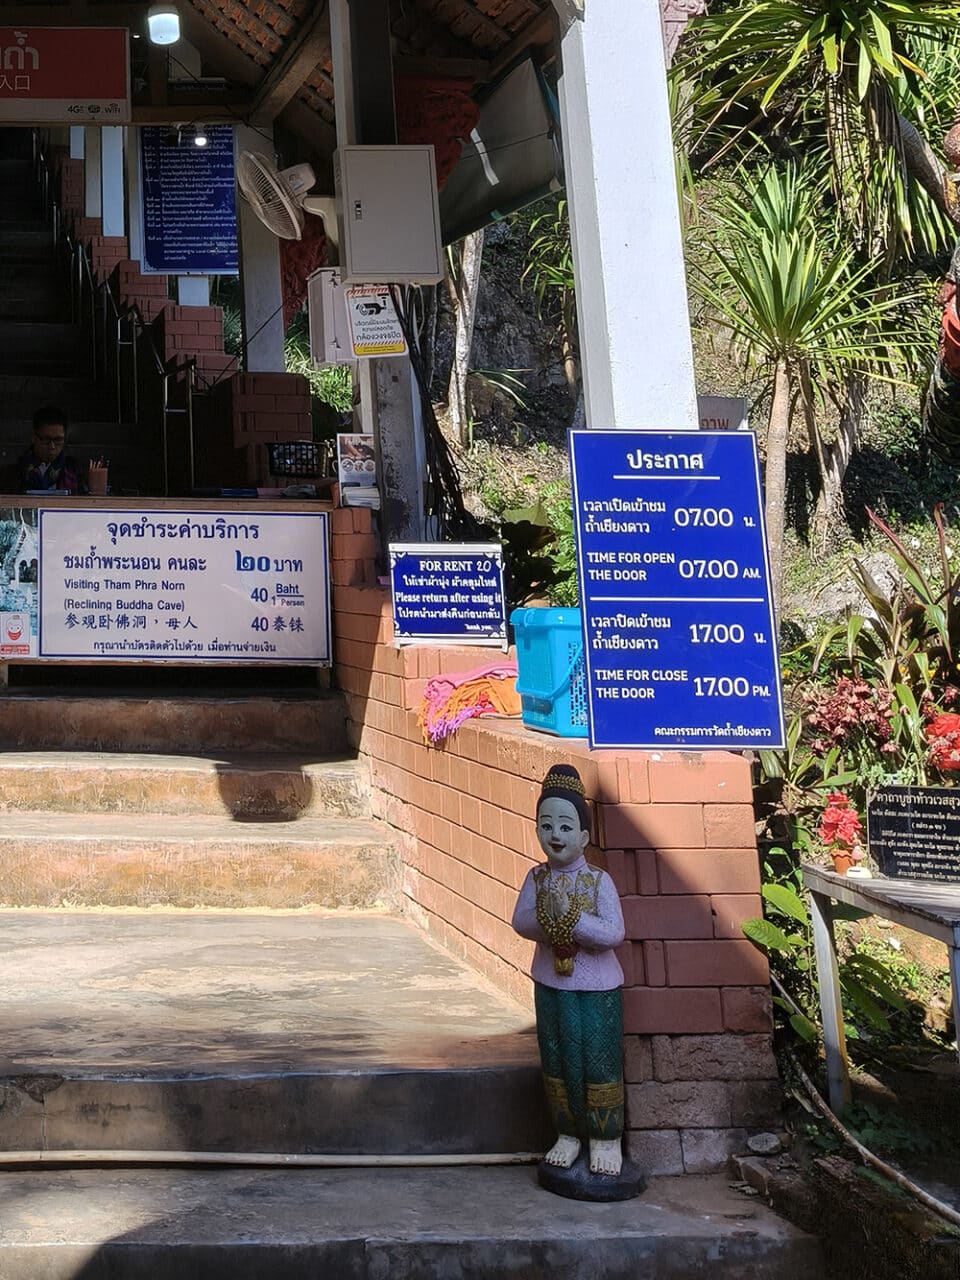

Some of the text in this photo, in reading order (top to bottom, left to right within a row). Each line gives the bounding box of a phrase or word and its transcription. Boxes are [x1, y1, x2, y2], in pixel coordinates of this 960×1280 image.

[626, 449, 704, 470] ประกาศ
[583, 498, 667, 514] เวลาเปิดเข้าชม
[584, 515, 650, 534] ถ้ำเชียงดาว
[673, 507, 756, 528] 07.00 น.
[106, 517, 259, 546] จุดชำระค่าบริการ
[63, 546, 303, 573] ชมถ้ำพระนอน คนละ ๒๐ บาท
[587, 552, 676, 564] TIME FOR OPEN
[419, 561, 492, 573] FOR RENT 20
[588, 569, 648, 581] THE DOOR
[678, 559, 761, 580] 07.00 AM.
[64, 579, 185, 592] Visiting Tham Phra Norn
[250, 583, 300, 603] 40 Baht
[63, 598, 185, 611] (Reclining Buddha Cave)
[271, 596, 276, 606] 1
[395, 592, 421, 603] Please
[422, 593, 448, 603] return
[450, 593, 470, 603] after
[471, 593, 494, 605] using
[250, 616, 305, 633] 40 泰铢
[591, 613, 671, 629] เวลาปิดเข้าชม
[592, 631, 659, 650] ถ้ำเชียงดาว
[689, 624, 767, 644] 17.00 น.
[93, 637, 277, 654] กรุณานำบัตรติดตัวไปด้วย เมื่อท่านจ่ายเงิน
[595, 669, 689, 682] TIME FOR CLOSE
[596, 687, 655, 699] THE DOOR
[693, 677, 771, 697] 17.00 PM.
[654, 722, 772, 738] คณะกรรมการวัดถ้ำเชียงดาว
